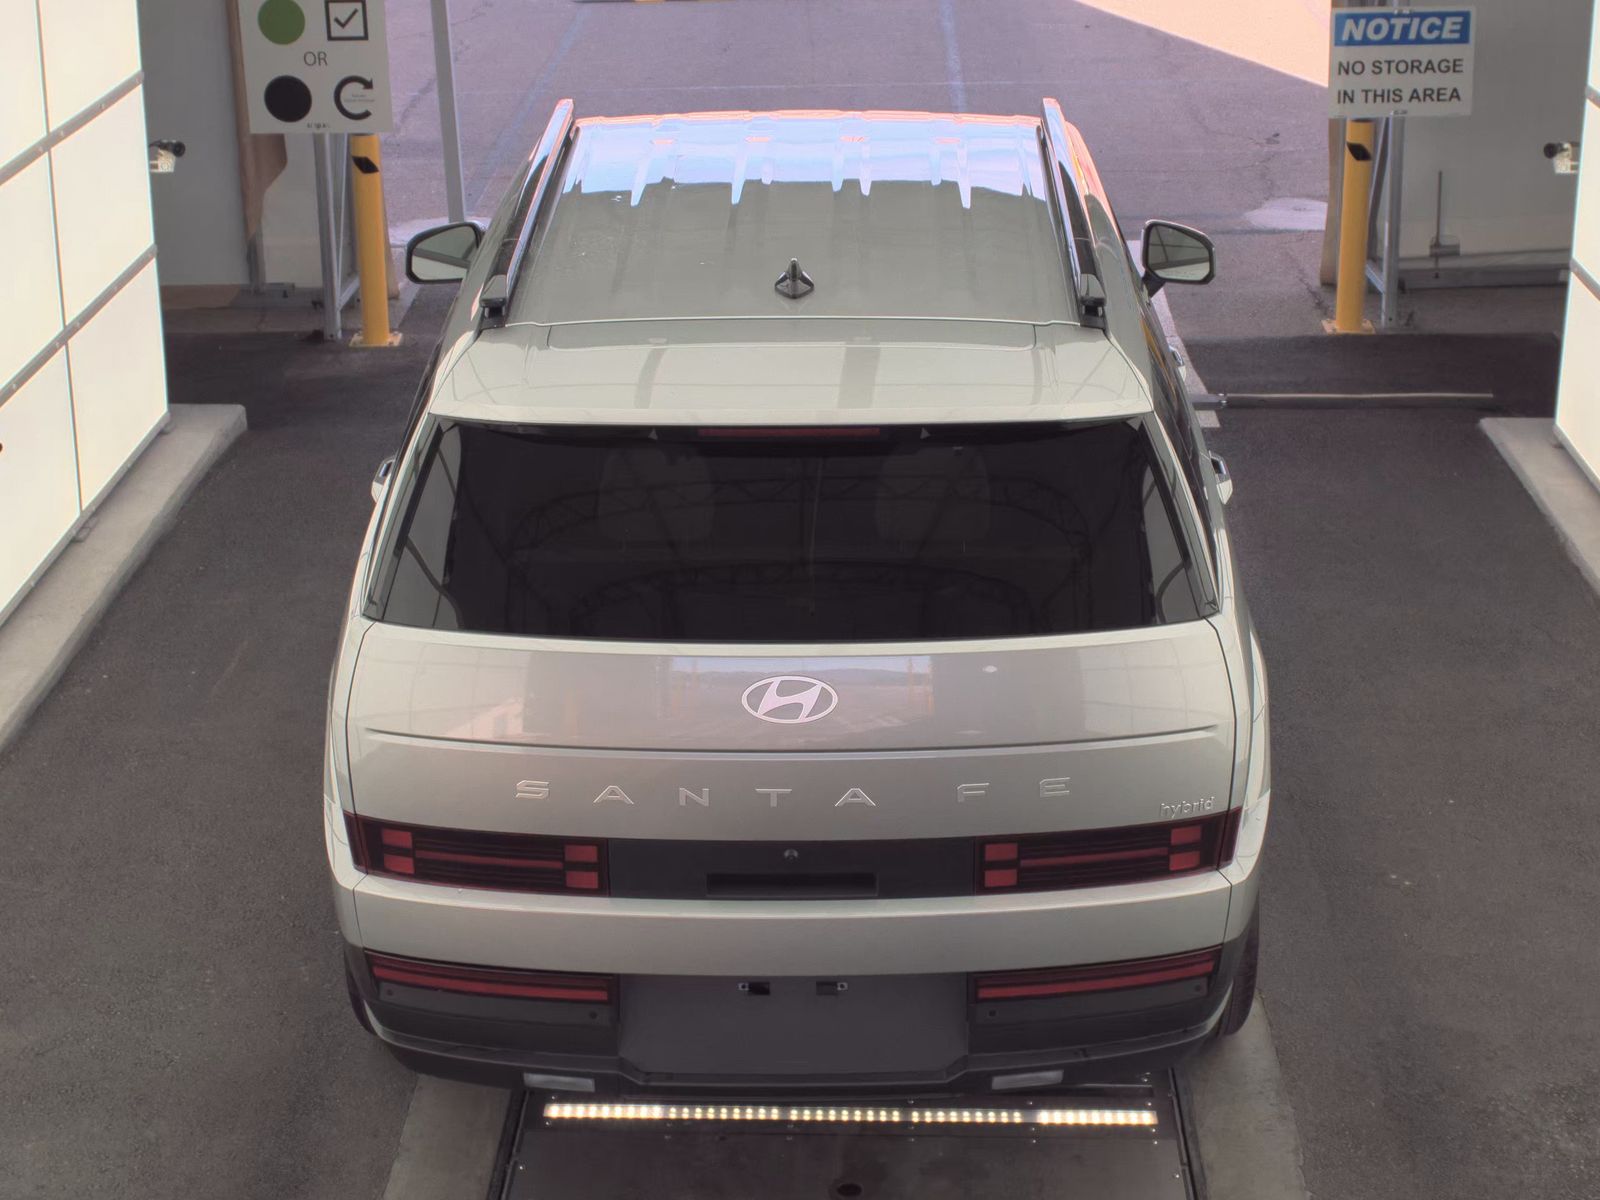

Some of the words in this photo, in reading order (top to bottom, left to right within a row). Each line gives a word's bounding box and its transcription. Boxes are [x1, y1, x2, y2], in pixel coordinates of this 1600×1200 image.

[1342, 16, 1464, 41] NOTICE
[303, 51, 328, 67] OR
[1338, 60, 1366, 75] NO
[1371, 58, 1464, 74] STORAGE
[1337, 89, 1355, 104] IN
[1361, 88, 1403, 104] THIS
[1408, 87, 1461, 103] AREA
[515, 779, 876, 807] SANTA
[957, 776, 1071, 802] FE
[1159, 796, 1215, 819] hybrid
